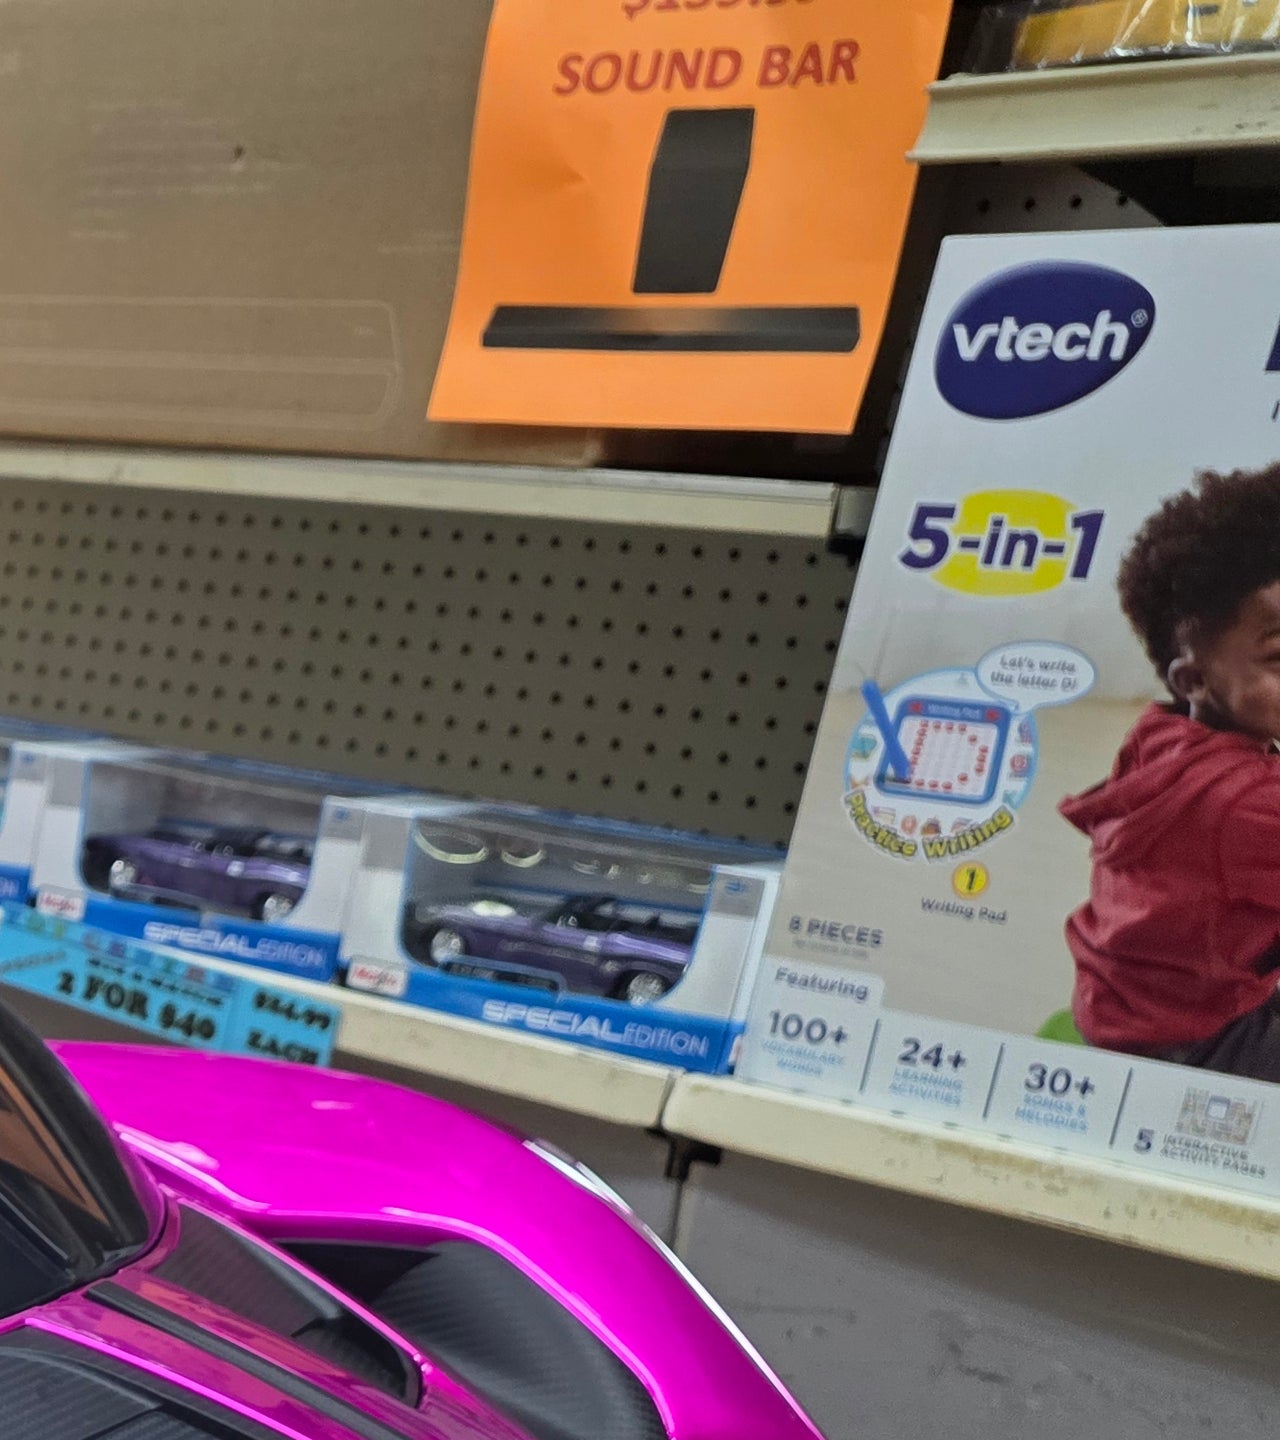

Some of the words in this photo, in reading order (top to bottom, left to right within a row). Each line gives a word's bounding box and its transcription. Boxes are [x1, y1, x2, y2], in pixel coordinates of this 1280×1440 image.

[553, 47, 743, 95] SOUND
[757, 39, 859, 88] BAR
[952, 309, 1130, 362] vtech
[899, 502, 1104, 579] 5-in-1
[922, 806, 1014, 859] Writing
[966, 868, 978, 891] 1
[921, 898, 974, 919] Writing
[978, 906, 1008, 923] Pad
[143, 920, 261, 958] SPECIAL
[789, 915, 802, 932] 8
[807, 918, 884, 947] PIECES
[82, 975, 149, 1020] FOR
[775, 967, 869, 1003] Featuring
[482, 999, 627, 1052] SPECIAL
[621, 1022, 711, 1058] EDITION
[769, 1008, 848, 1045] 100+
[897, 1036, 966, 1071] 24+
[1023, 1063, 1095, 1098] 30+
[1133, 1128, 1155, 1152] 5
